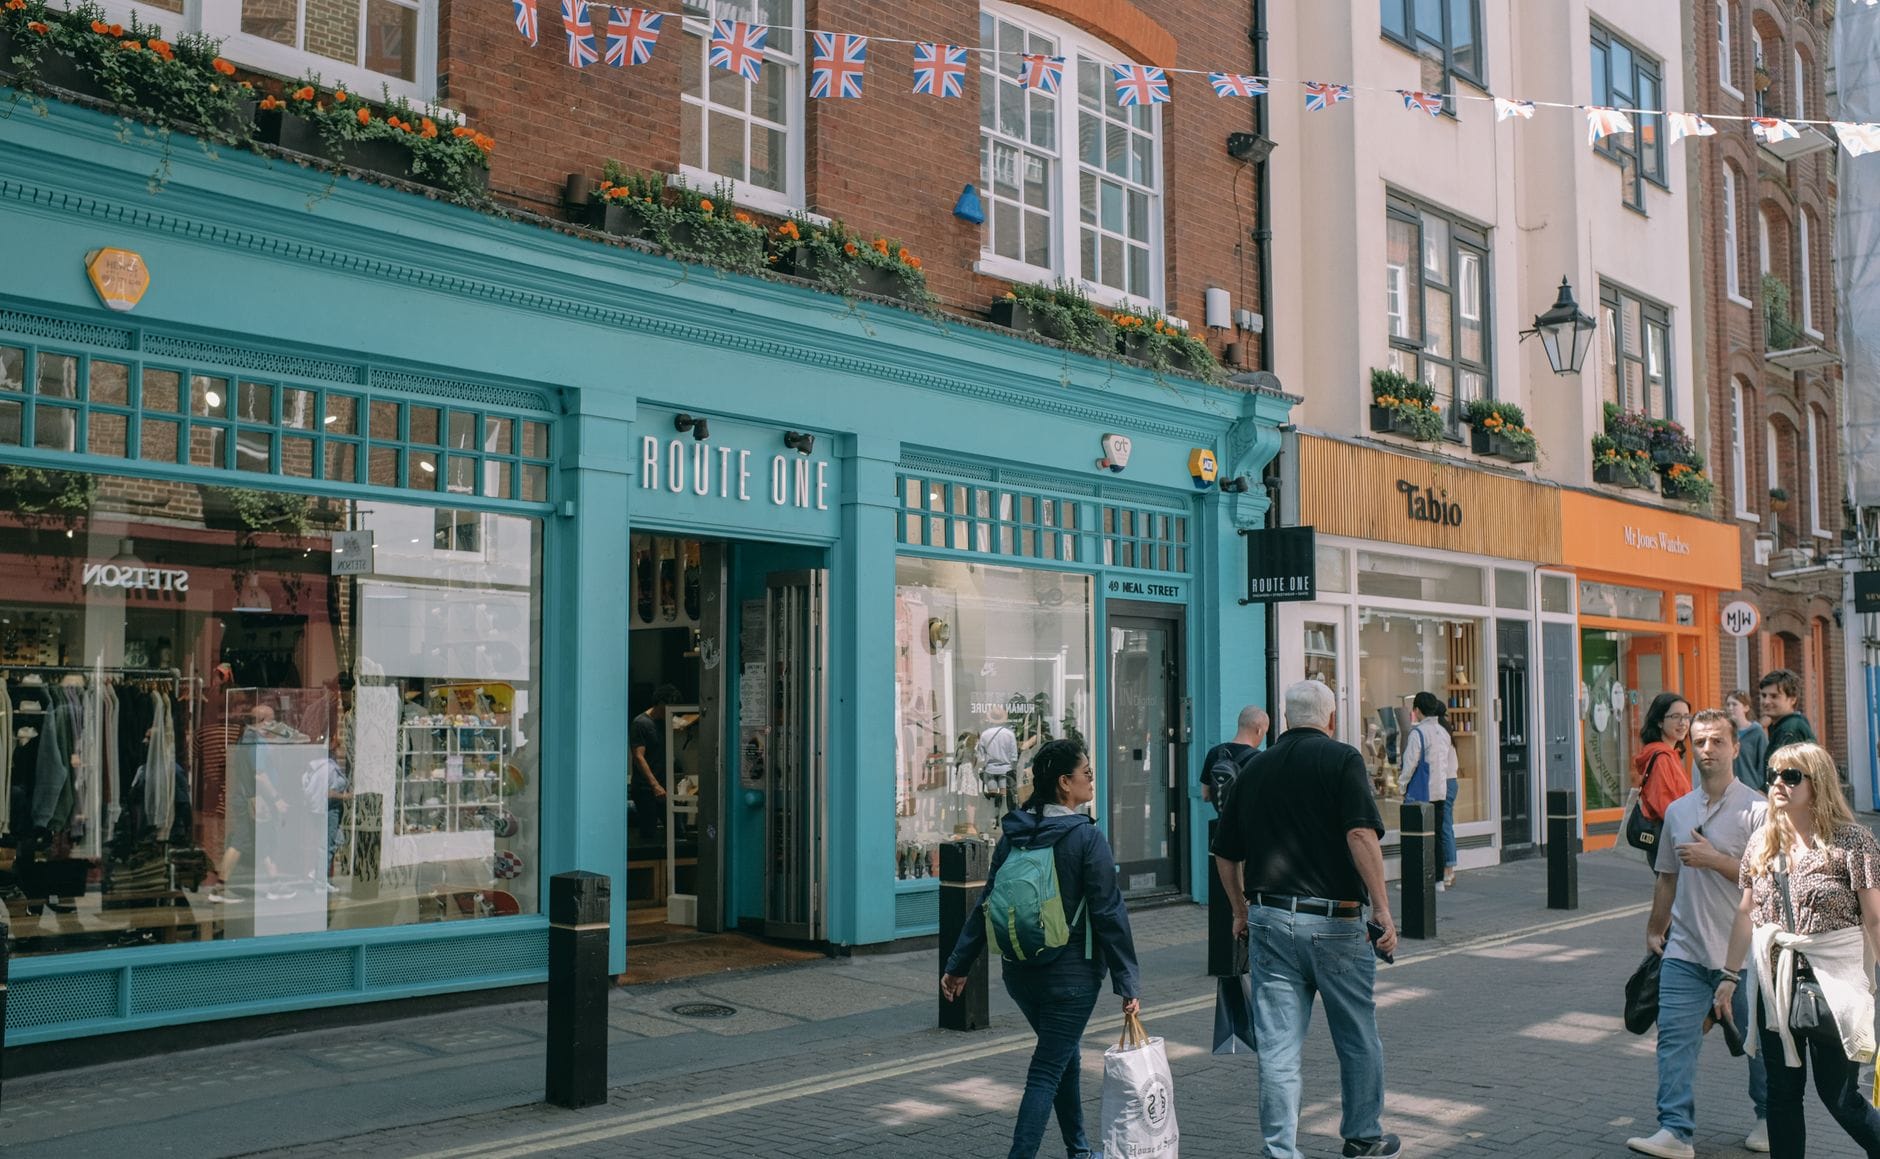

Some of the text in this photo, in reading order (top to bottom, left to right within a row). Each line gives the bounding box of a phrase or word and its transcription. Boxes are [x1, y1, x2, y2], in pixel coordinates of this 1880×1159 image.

[642, 435, 829, 511] ROUTE ONE
[1396, 479, 1462, 527] Tabio
[1624, 526, 1690, 555] Mr Jones Watches
[1108, 580, 1179, 597] 49 NEAL STREET
[1252, 576, 1309, 593] ROUTE ONE
[1727, 610, 1751, 633] MJW
